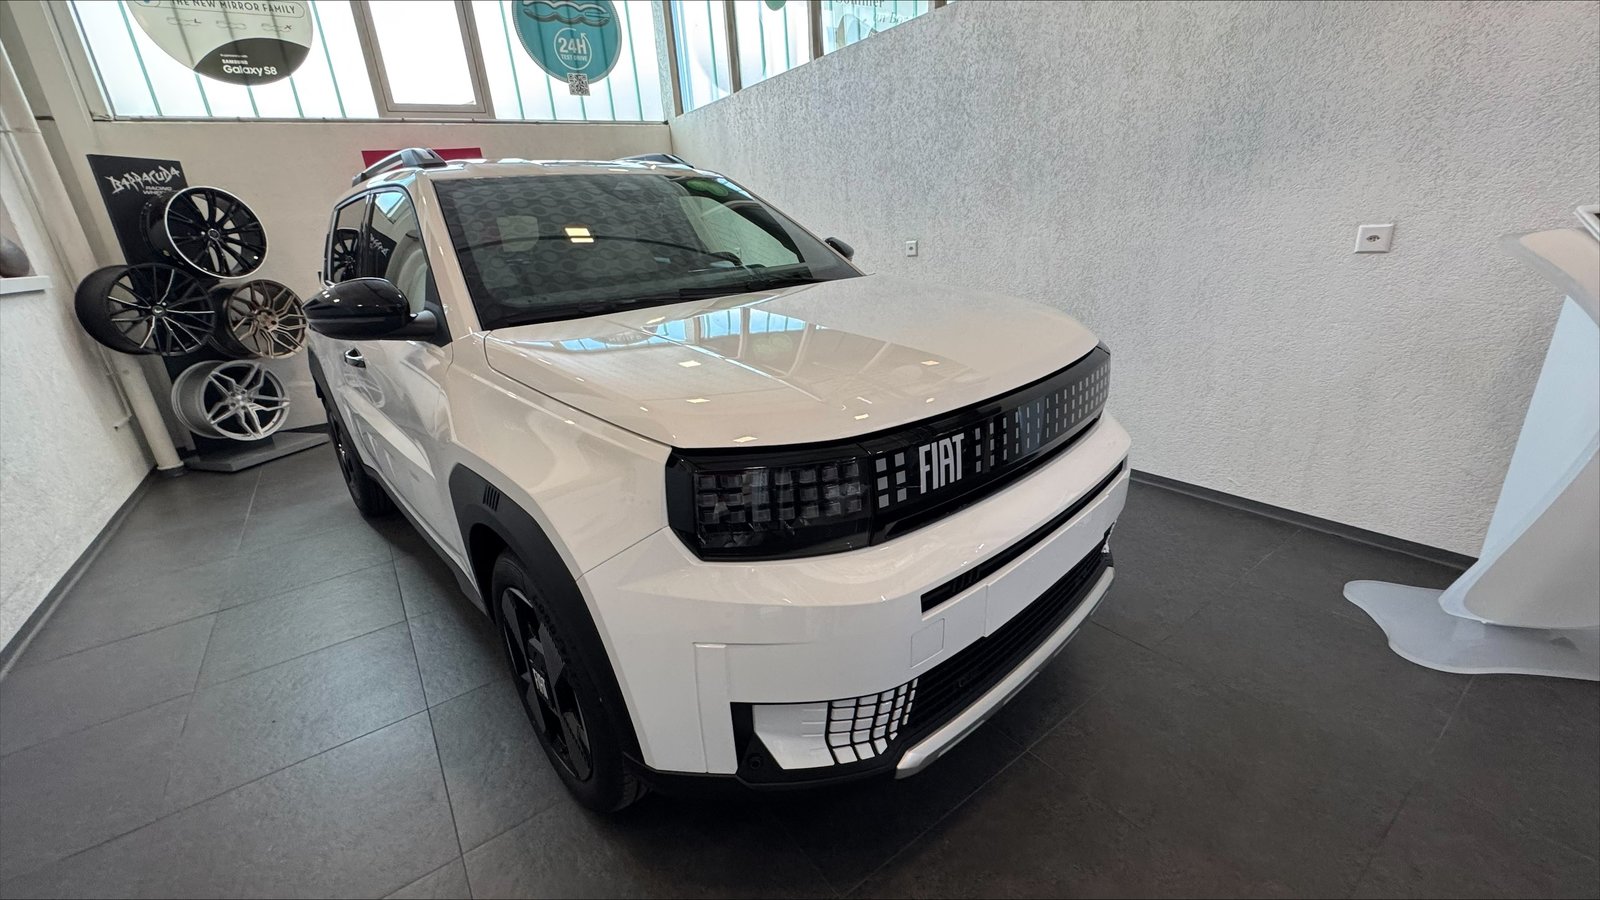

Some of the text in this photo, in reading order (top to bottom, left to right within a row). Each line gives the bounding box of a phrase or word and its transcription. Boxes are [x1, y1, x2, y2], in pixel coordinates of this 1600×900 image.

[219, 1, 260, 11] MIRROR
[262, 3, 296, 14] FAMILY
[558, 37, 587, 54] 24H
[223, 64, 278, 77] Galaxy S8
[104, 165, 181, 195] BARRACUDA
[918, 432, 965, 494] FIAT
